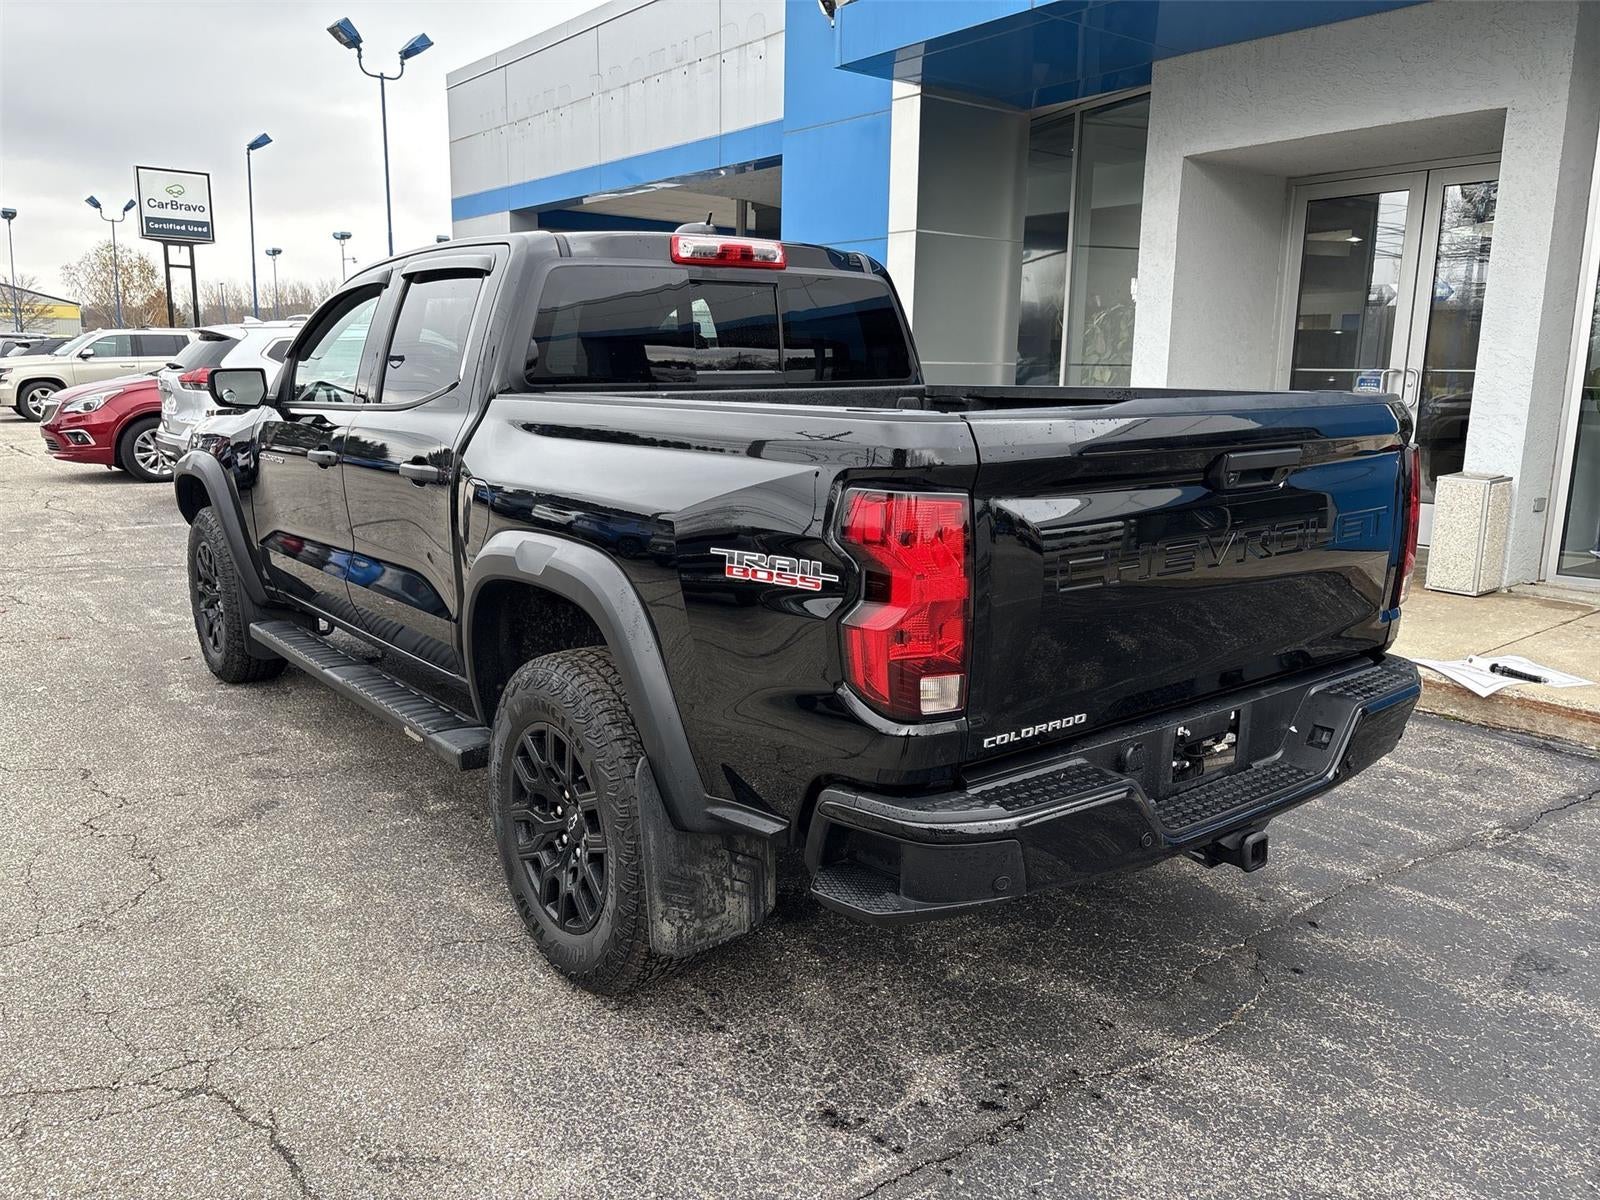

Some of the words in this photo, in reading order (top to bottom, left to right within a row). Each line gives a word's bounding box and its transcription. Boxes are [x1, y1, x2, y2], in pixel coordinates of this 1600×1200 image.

[147, 198, 206, 213] CarBravo
[149, 222, 186, 231] Certified
[188, 225, 208, 233] Used
[1057, 505, 1388, 592] CHEVROLET
[710, 547, 839, 582] TRAIL
[726, 564, 822, 591] BOSS
[983, 713, 1087, 748] COLORADO
